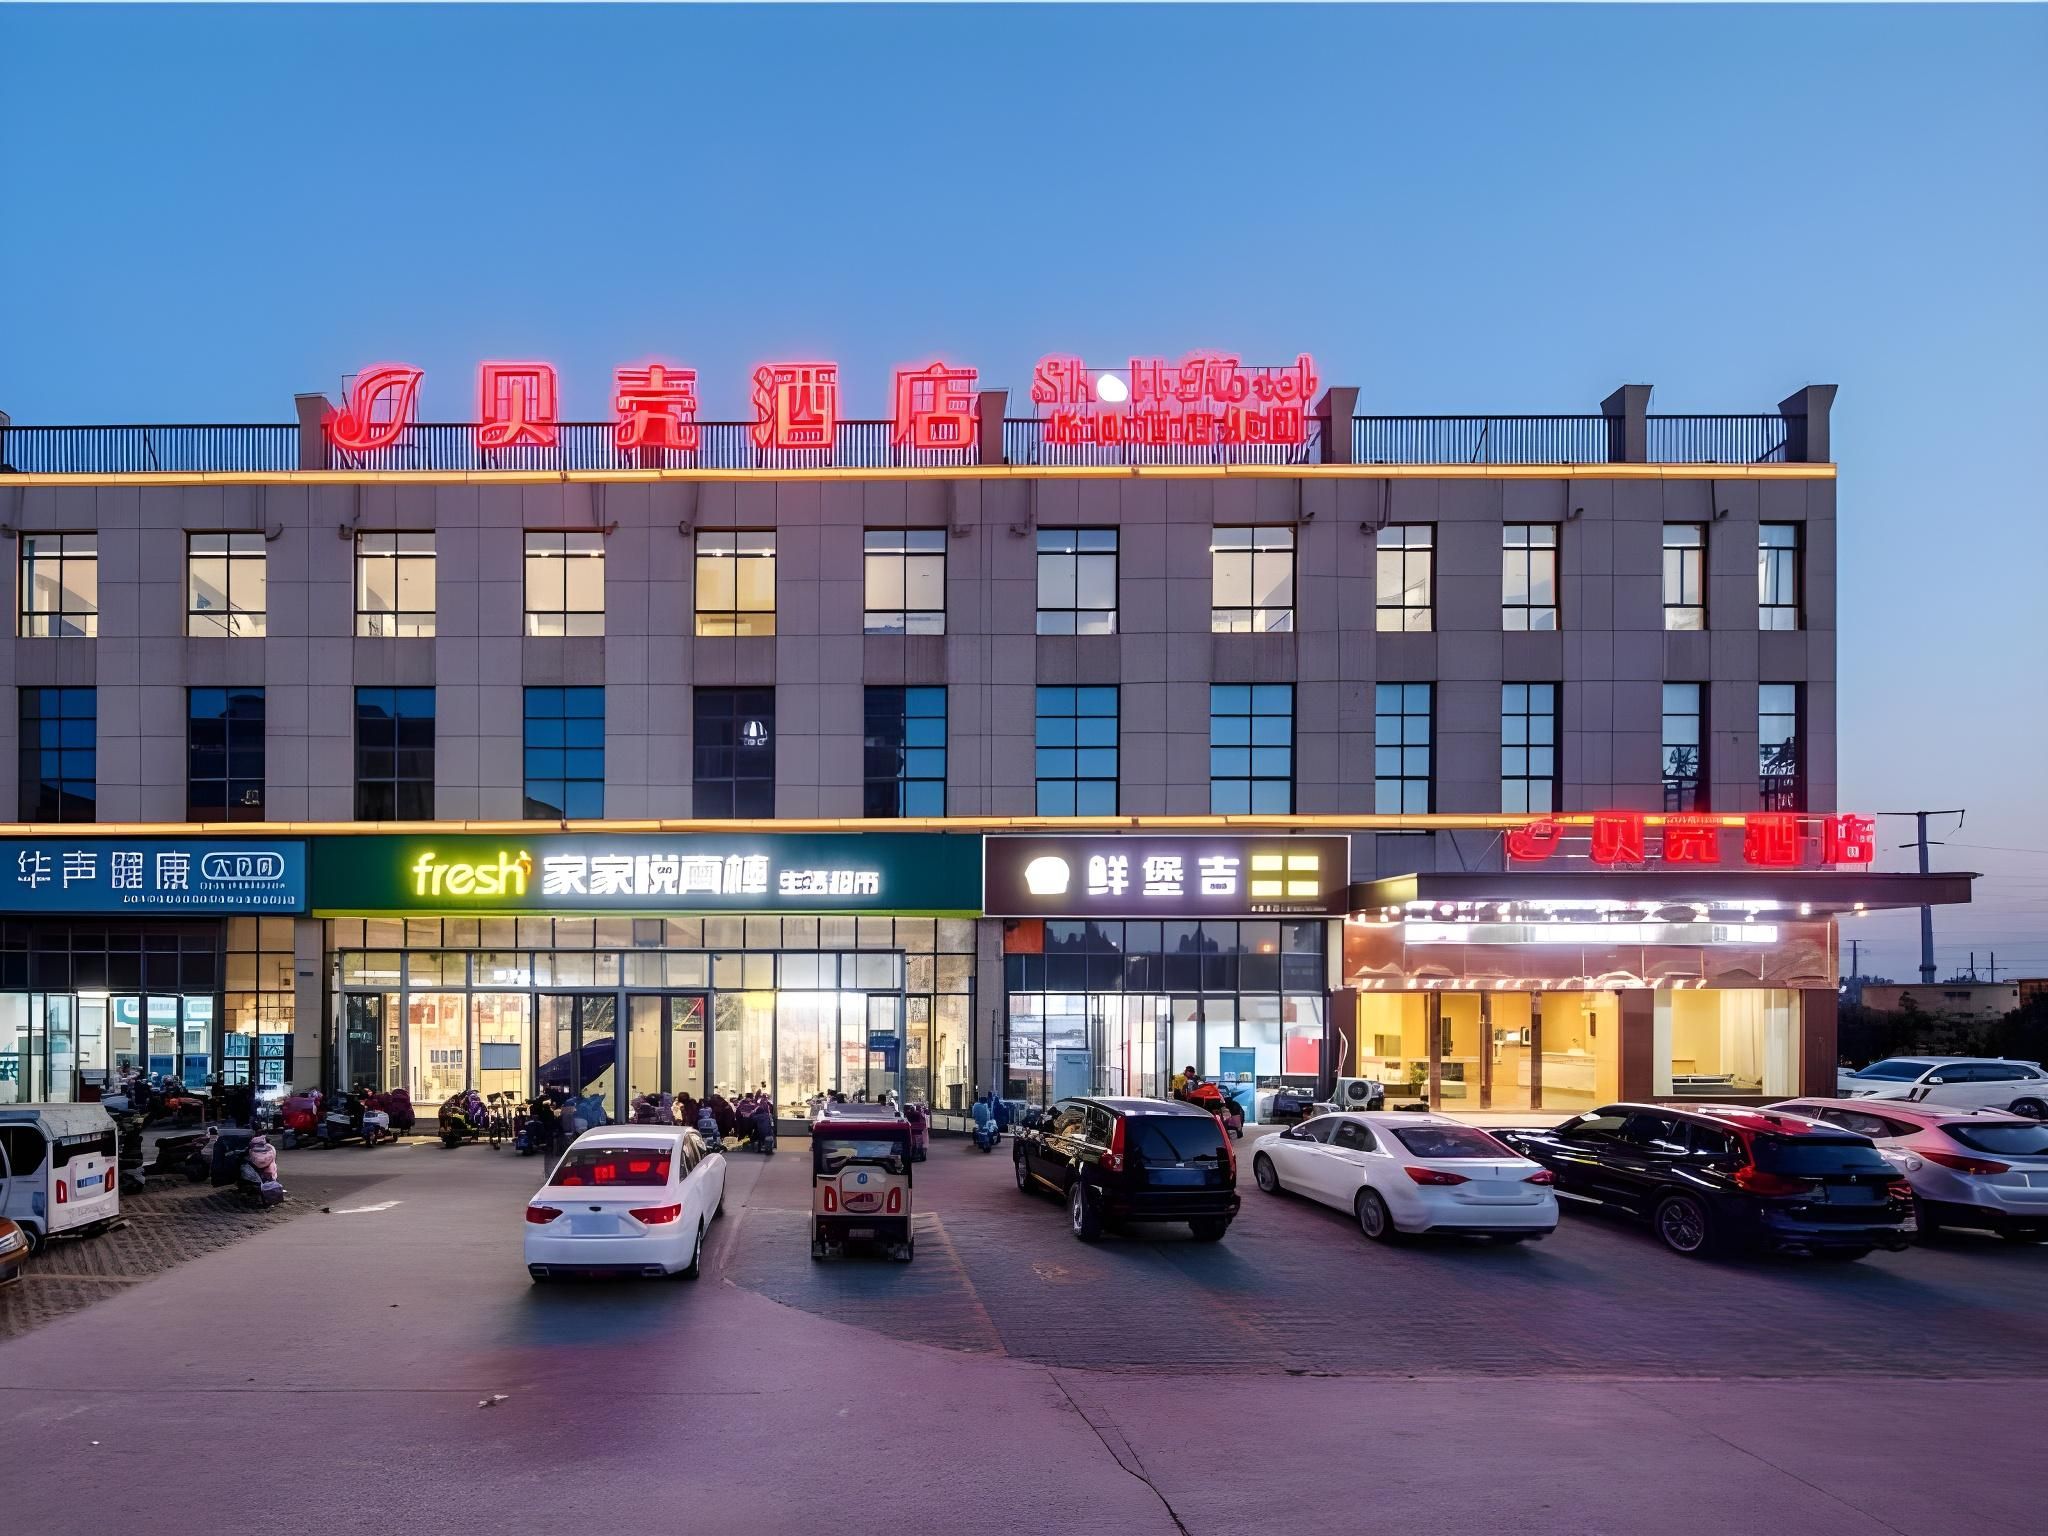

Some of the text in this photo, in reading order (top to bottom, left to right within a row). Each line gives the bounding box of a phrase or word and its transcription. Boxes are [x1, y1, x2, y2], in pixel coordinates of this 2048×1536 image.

[480, 362, 979, 449] 贝壳酒店
[412, 851, 526, 896] fresh
[1088, 855, 1240, 896] 鲜堡吉
